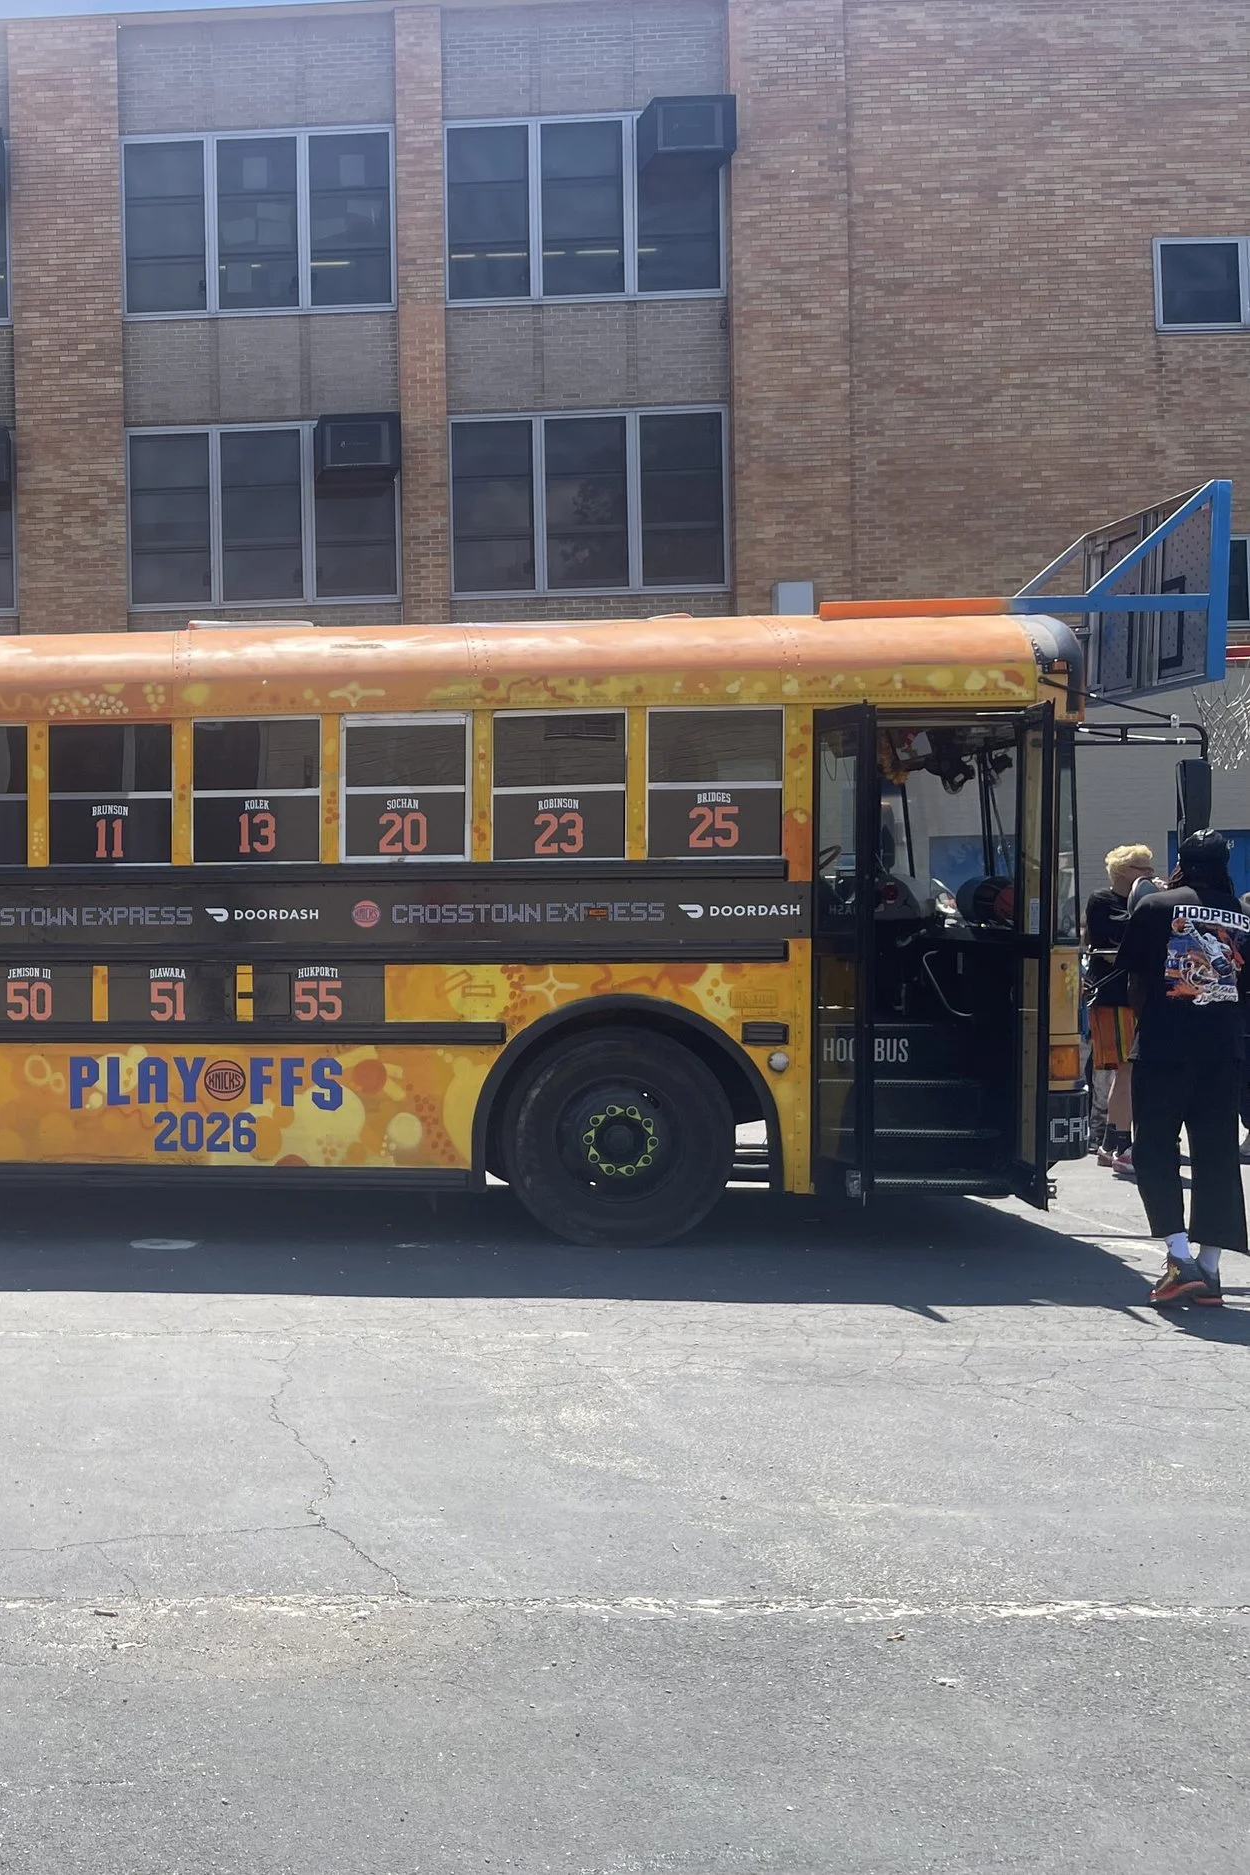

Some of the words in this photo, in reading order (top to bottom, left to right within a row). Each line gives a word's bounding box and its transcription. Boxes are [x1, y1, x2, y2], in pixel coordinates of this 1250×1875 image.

[244, 800, 269, 810] KOLEK
[386, 799, 418, 810] SOCHAN
[537, 799, 579, 811] ROBINSON
[697, 791, 731, 804] BRIDGES
[92, 805, 129, 817] BRUNSON
[238, 812, 277, 853] 13
[378, 812, 427, 854] 20
[534, 812, 584, 855] 23
[688, 805, 739, 848] 25
[95, 819, 124, 858] 11
[82, 906, 193, 926] EXPRESS
[234, 909, 319, 920] DOORDASH
[392, 903, 541, 924] CROSSTOWN
[709, 904, 801, 917] DOORDASH
[1174, 906, 1250, 931] HOOPBUS
[7, 968, 40, 979] JEMISON
[42, 967, 51, 979] III
[149, 967, 186, 979] DIAWARA
[297, 967, 338, 979] HUKPORTI
[7, 981, 52, 1021] 50
[150, 981, 186, 1021] 51
[295, 981, 342, 1021] 55
[208, 1069, 242, 1091] KNICKS
[154, 1111, 256, 1152] 2026
